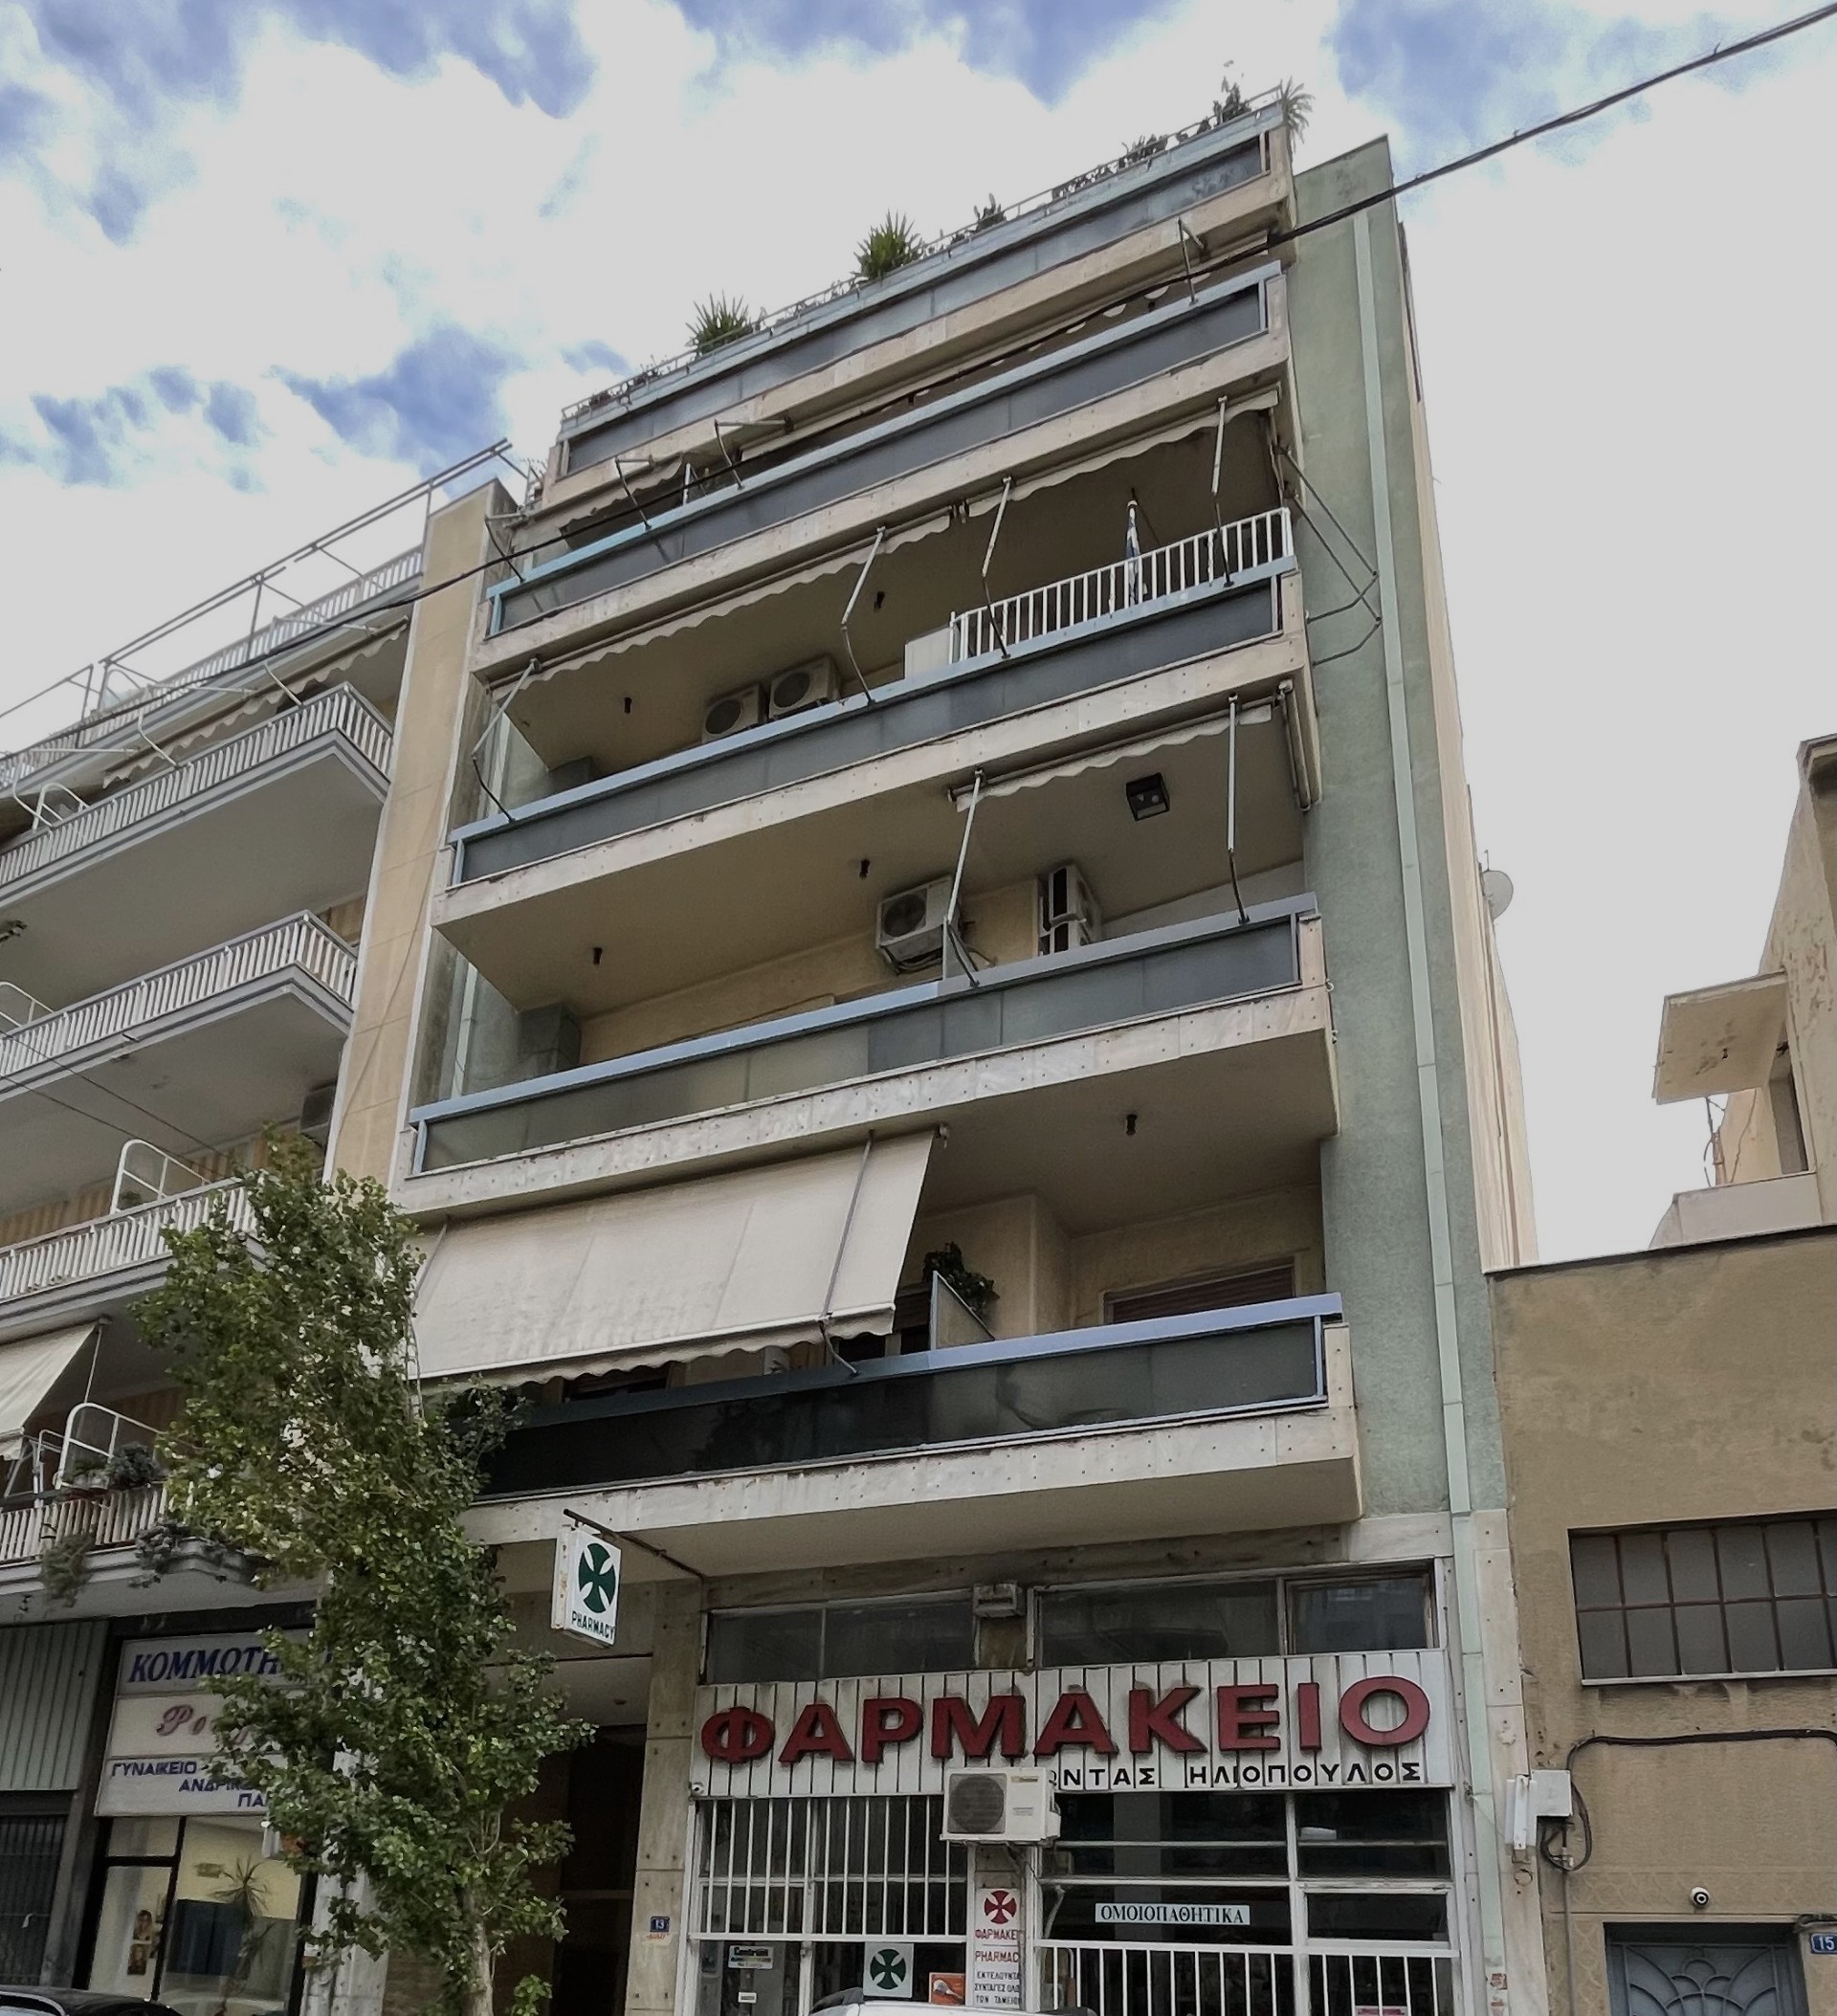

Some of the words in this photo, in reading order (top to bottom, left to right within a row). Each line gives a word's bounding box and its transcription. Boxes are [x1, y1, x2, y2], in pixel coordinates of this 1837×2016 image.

[571, 1610, 614, 1640] PHARMACY
[127, 1646, 333, 1683] ΚΟΜΜΩΤΗ
[700, 1674, 1431, 1764] ΦΑΡΜΑΚΕΙΟ
[111, 1761, 197, 1777] ΓΥΝΑΙΚΕΙΟ
[1189, 1761, 1421, 1783] ΗΛΙΟΠΟΥΛΟΣ
[1100, 1905, 1244, 1924] ΟΜΟΙΟΠΑΘΗΤΙΚΑ
[1819, 1936, 1835, 1950] 15
[975, 1951, 1020, 1962] PHARMAC
